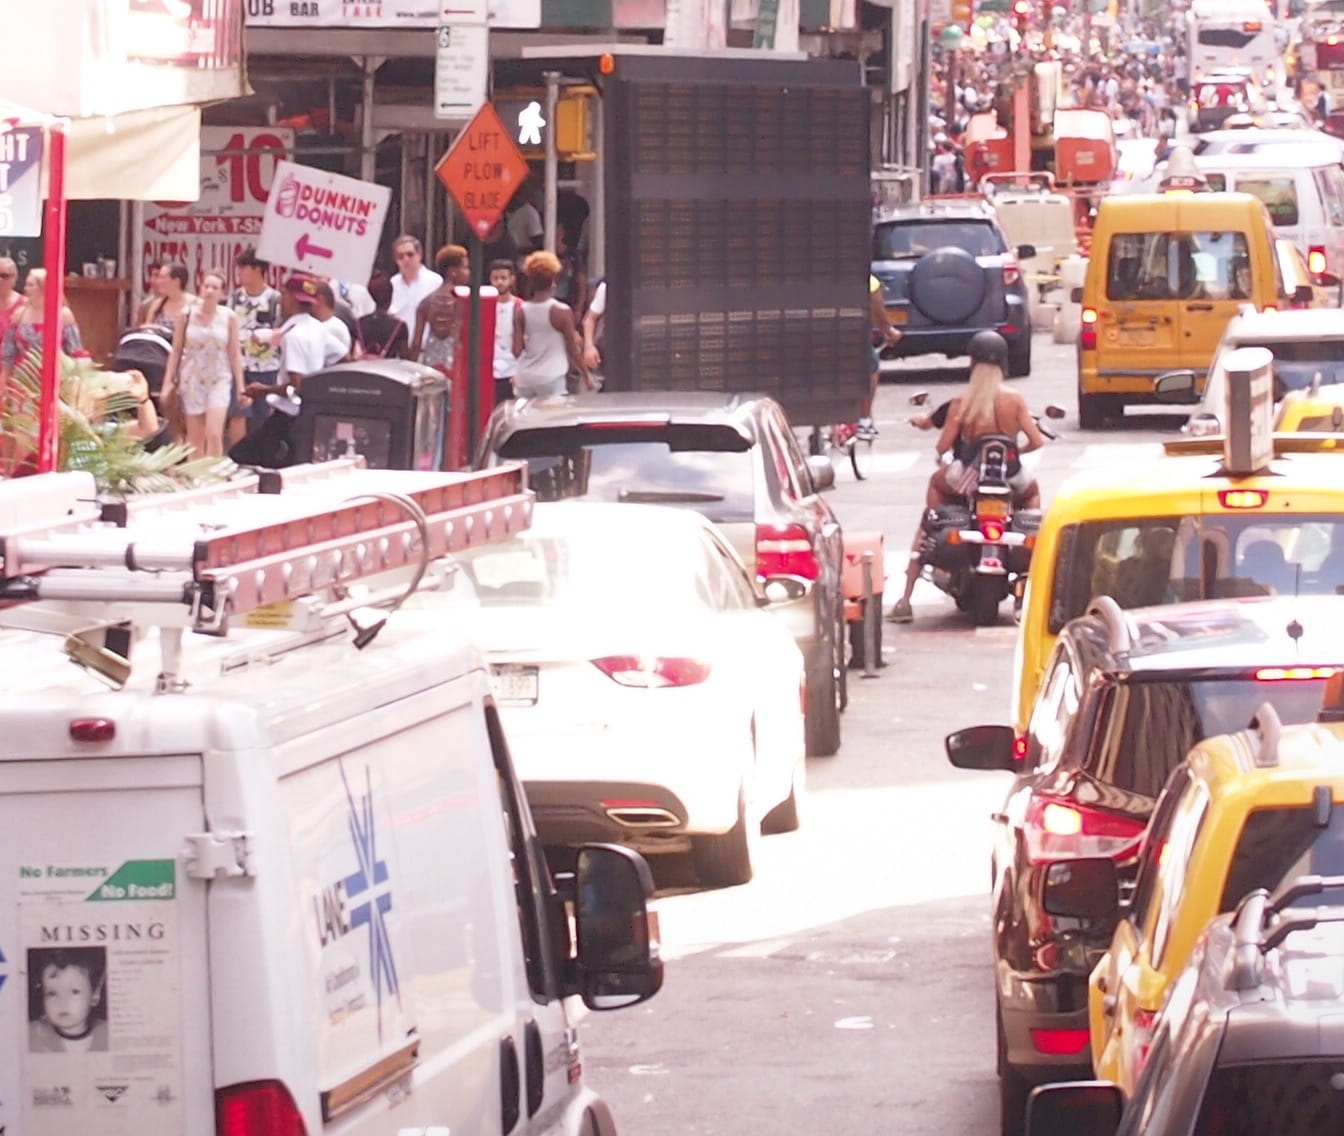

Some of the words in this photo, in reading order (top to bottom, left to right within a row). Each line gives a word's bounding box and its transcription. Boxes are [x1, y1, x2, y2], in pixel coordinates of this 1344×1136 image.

[289, 1, 320, 17] BAR
[467, 132, 499, 153] LIFT
[463, 160, 503, 181] PLOW
[300, 184, 377, 218] DUNKIN'
[463, 189, 502, 211] BLADE
[155, 218, 189, 232] New
[192, 217, 227, 232] York
[297, 203, 369, 237] DONUTS
[19, 865, 40, 878] No
[45, 864, 109, 878] Farmers
[101, 883, 124, 899] No
[127, 882, 174, 899] Food!
[41, 921, 166, 943] MISSING
